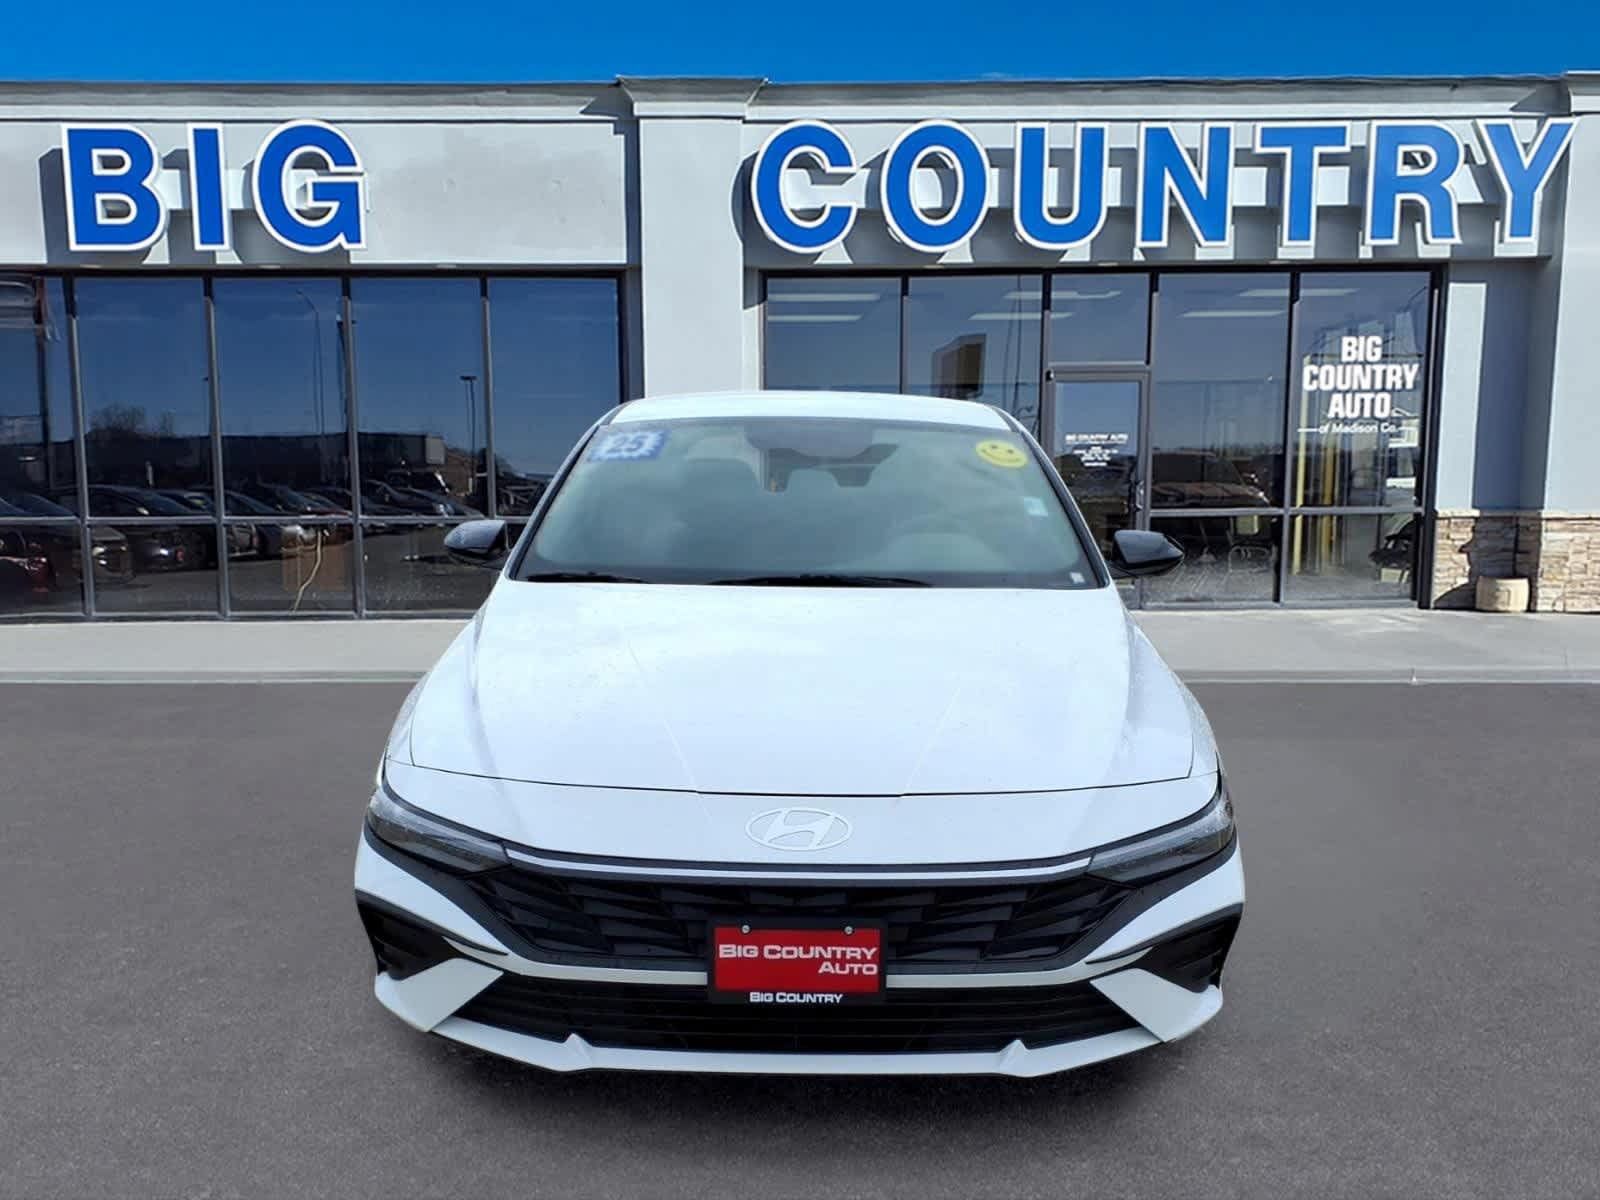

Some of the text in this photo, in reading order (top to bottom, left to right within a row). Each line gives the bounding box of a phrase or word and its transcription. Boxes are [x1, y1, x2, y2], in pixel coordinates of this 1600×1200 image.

[61, 116, 1578, 255] BIG COUNTRY
[1341, 335, 1383, 362] BIG
[1302, 363, 1420, 391] COUNTRY
[1327, 392, 1392, 419] AUTO
[1318, 422, 1330, 434] of
[1331, 422, 1378, 433] Madison
[718, 943, 878, 960] BIG COUNTRY
[818, 961, 878, 976] AUTO
[749, 991, 844, 1004] BIG COUNTRY
